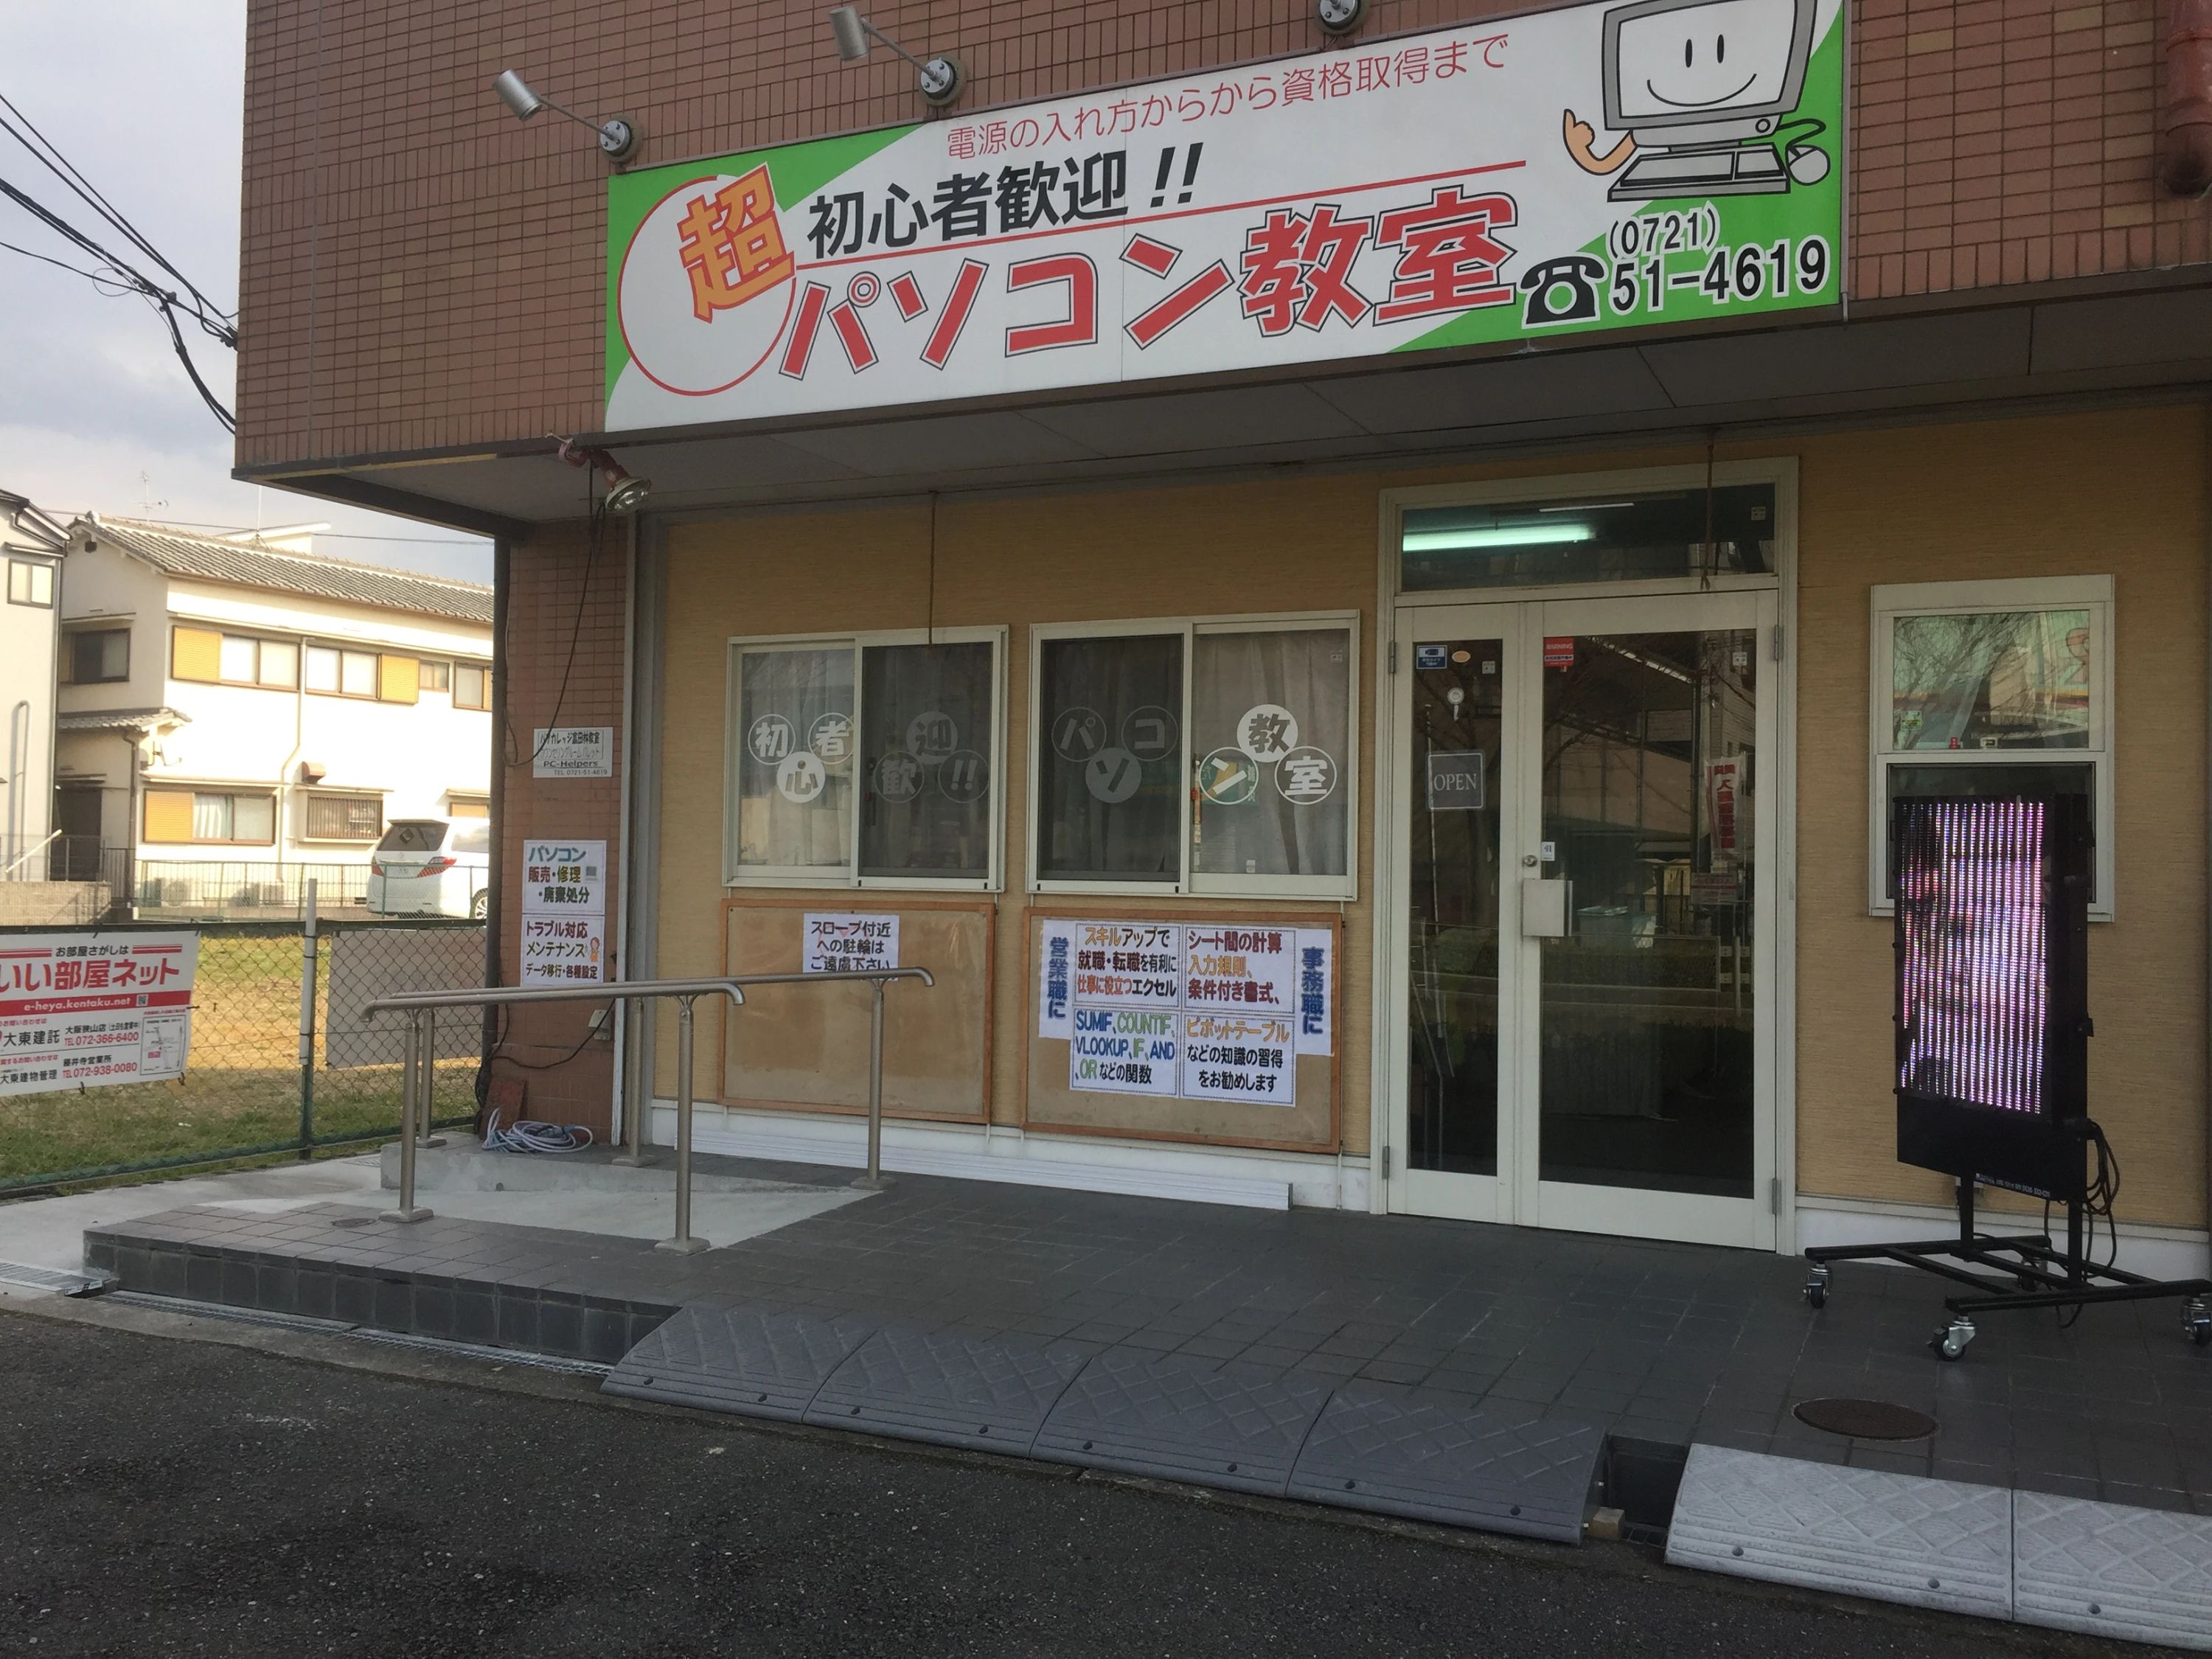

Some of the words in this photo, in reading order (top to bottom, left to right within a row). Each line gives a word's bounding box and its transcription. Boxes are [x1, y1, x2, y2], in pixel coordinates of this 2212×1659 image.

[947, 32, 1509, 160] 電源の入れ方からから資格取得まで
[1610, 201, 1719, 261] (0721)
[678, 162, 796, 324] 超
[779, 184, 1517, 380] パソコン教室
[1610, 237, 1829, 317] 51-4619
[1433, 773, 1478, 792] OPEN
[529, 845, 587, 863] パソコン
[528, 866, 582, 883] 販売・修理
[526, 920, 588, 939] トラブル対応
[811, 920, 891, 938] スロープ付近
[1085, 926, 1171, 947] スキルアップで
[55, 945, 129, 957] お部屋さがしは
[526, 941, 585, 958] メンテナンス
[817, 939, 885, 955] への駐輪は
[1188, 931, 1282, 953] シート間の計算
[526, 963, 598, 980] データ移行・各種設定
[811, 955, 890, 972] ご遠慮下さい
[1077, 951, 1177, 973] 就職・転職を有利に
[0, 958, 179, 992] いい部屋ネット
[1047, 936, 1069, 1020] 営業職に
[1077, 975, 1177, 998] 仕事に役立つエクセル
[1301, 946, 1325, 1035] 事務職に
[24, 998, 131, 1012] e-heya.kentaku.net
[4, 1029, 60, 1047] 大東建託
[65, 1023, 106, 1034] 大阪狭山店
[1186, 1018, 1290, 1043] ピボットテーブル
[75, 1032, 139, 1046] 072-366-6400
[63, 1055, 111, 1067] 藤井寺営業所
[1187, 1046, 1283, 1069] などの知識の習得
[0, 1069, 57, 1085] 大東建物管理
[74, 1062, 137, 1078] 072-938-0080
[1199, 1069, 1277, 1093] をお勧めします
